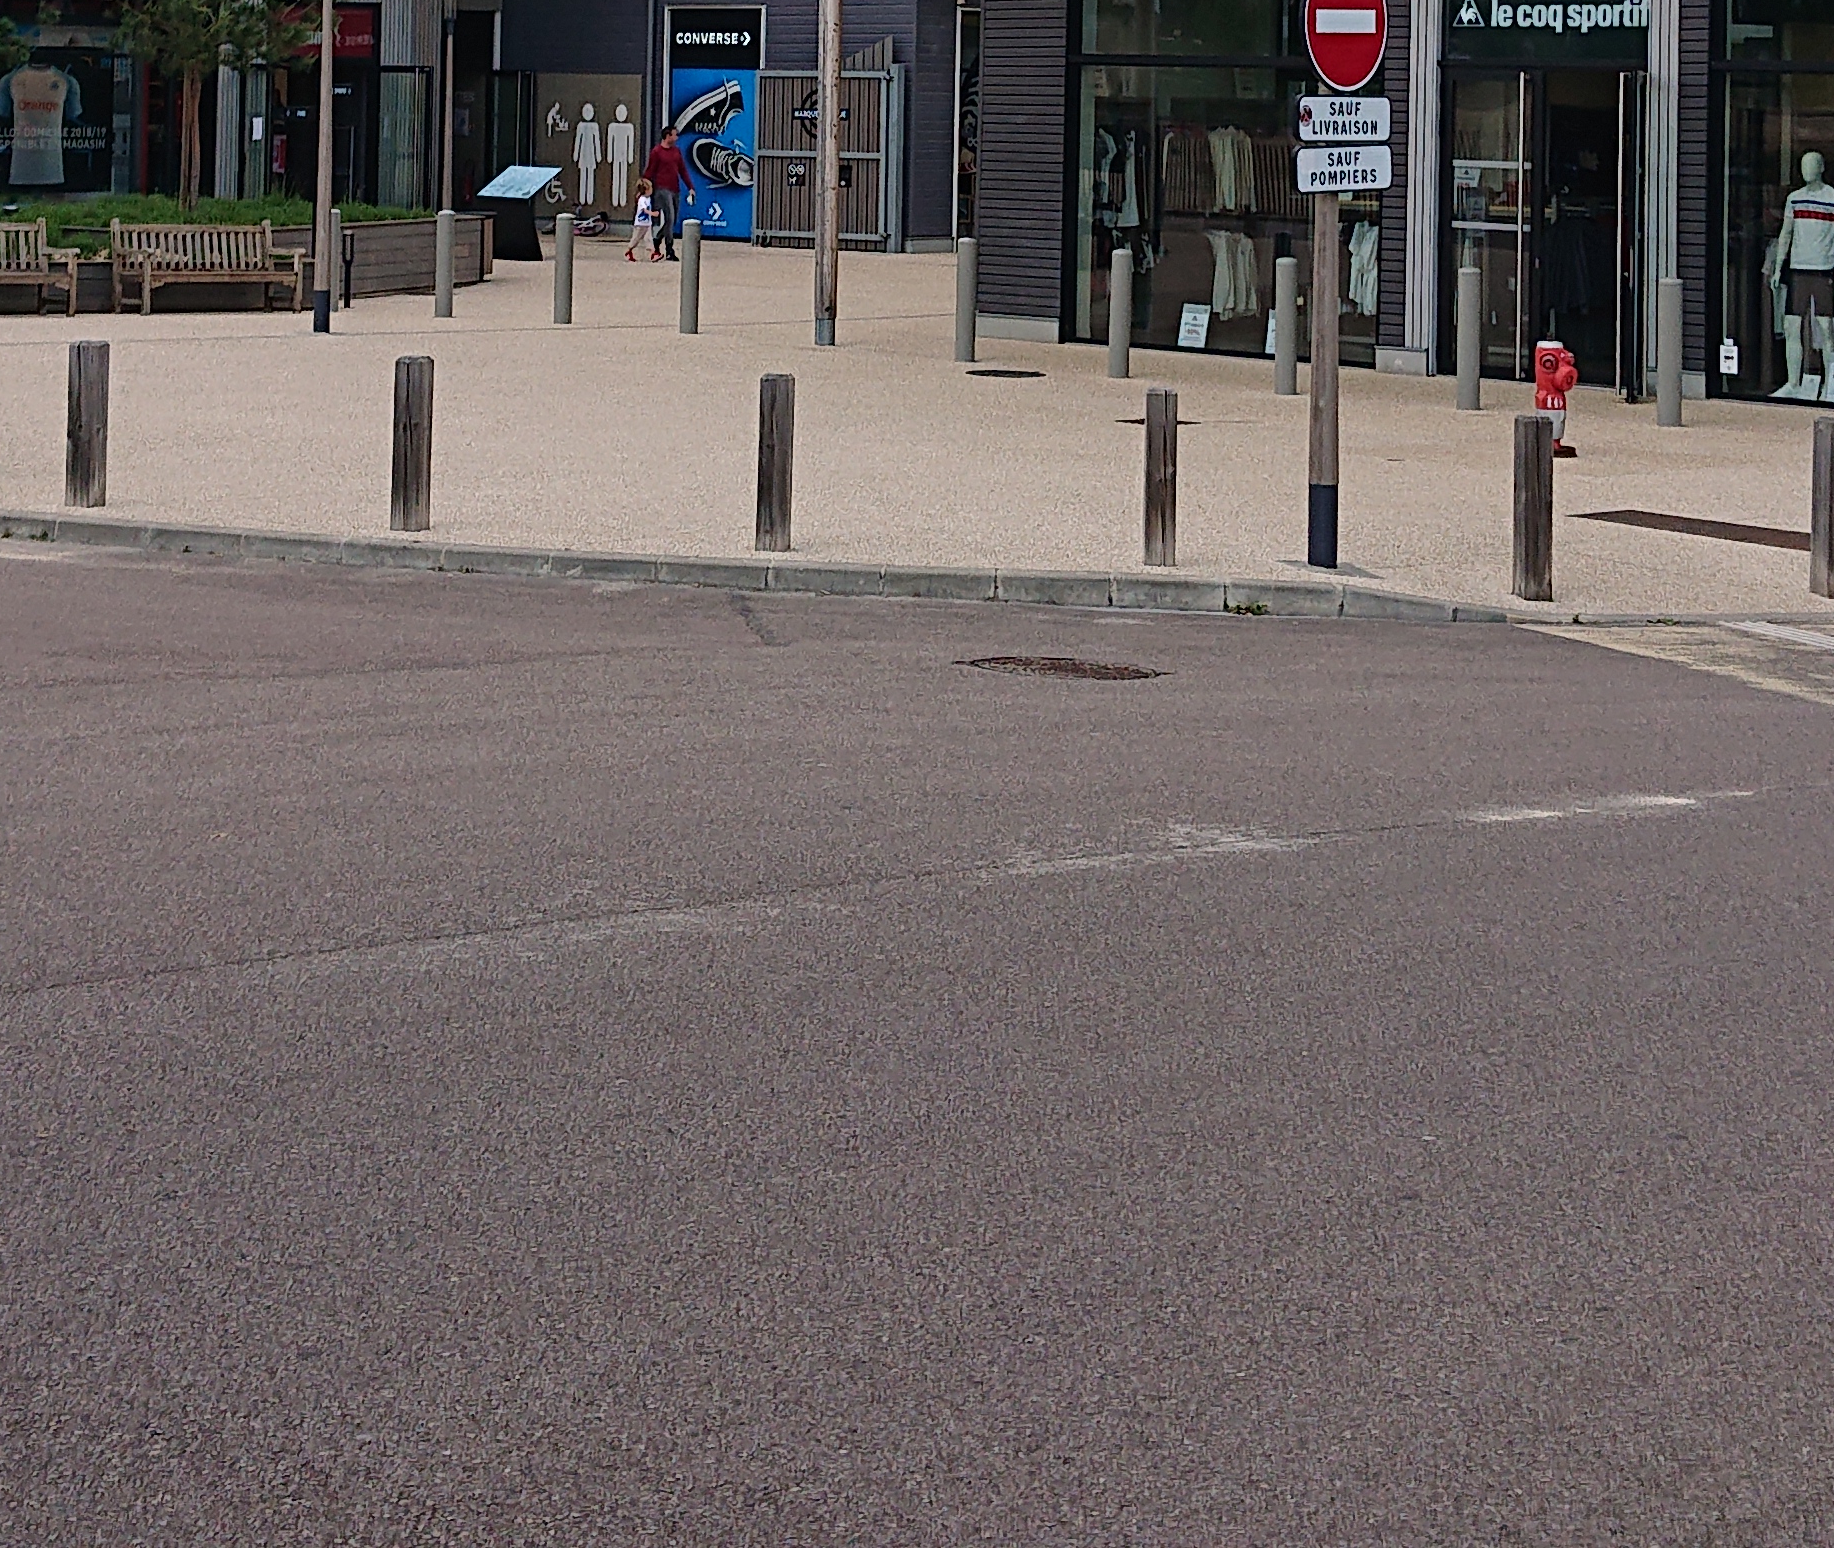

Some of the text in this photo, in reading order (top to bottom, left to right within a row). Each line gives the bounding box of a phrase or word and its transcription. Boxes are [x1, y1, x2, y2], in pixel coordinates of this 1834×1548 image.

[1517, 4, 1563, 33] coq
[676, 32, 739, 45] CONVERSE
[1329, 100, 1362, 117] SAUF
[1312, 119, 1378, 136] LIVRAISON
[1328, 151, 1361, 167] SAUF
[1311, 169, 1377, 186] POMPIERS
